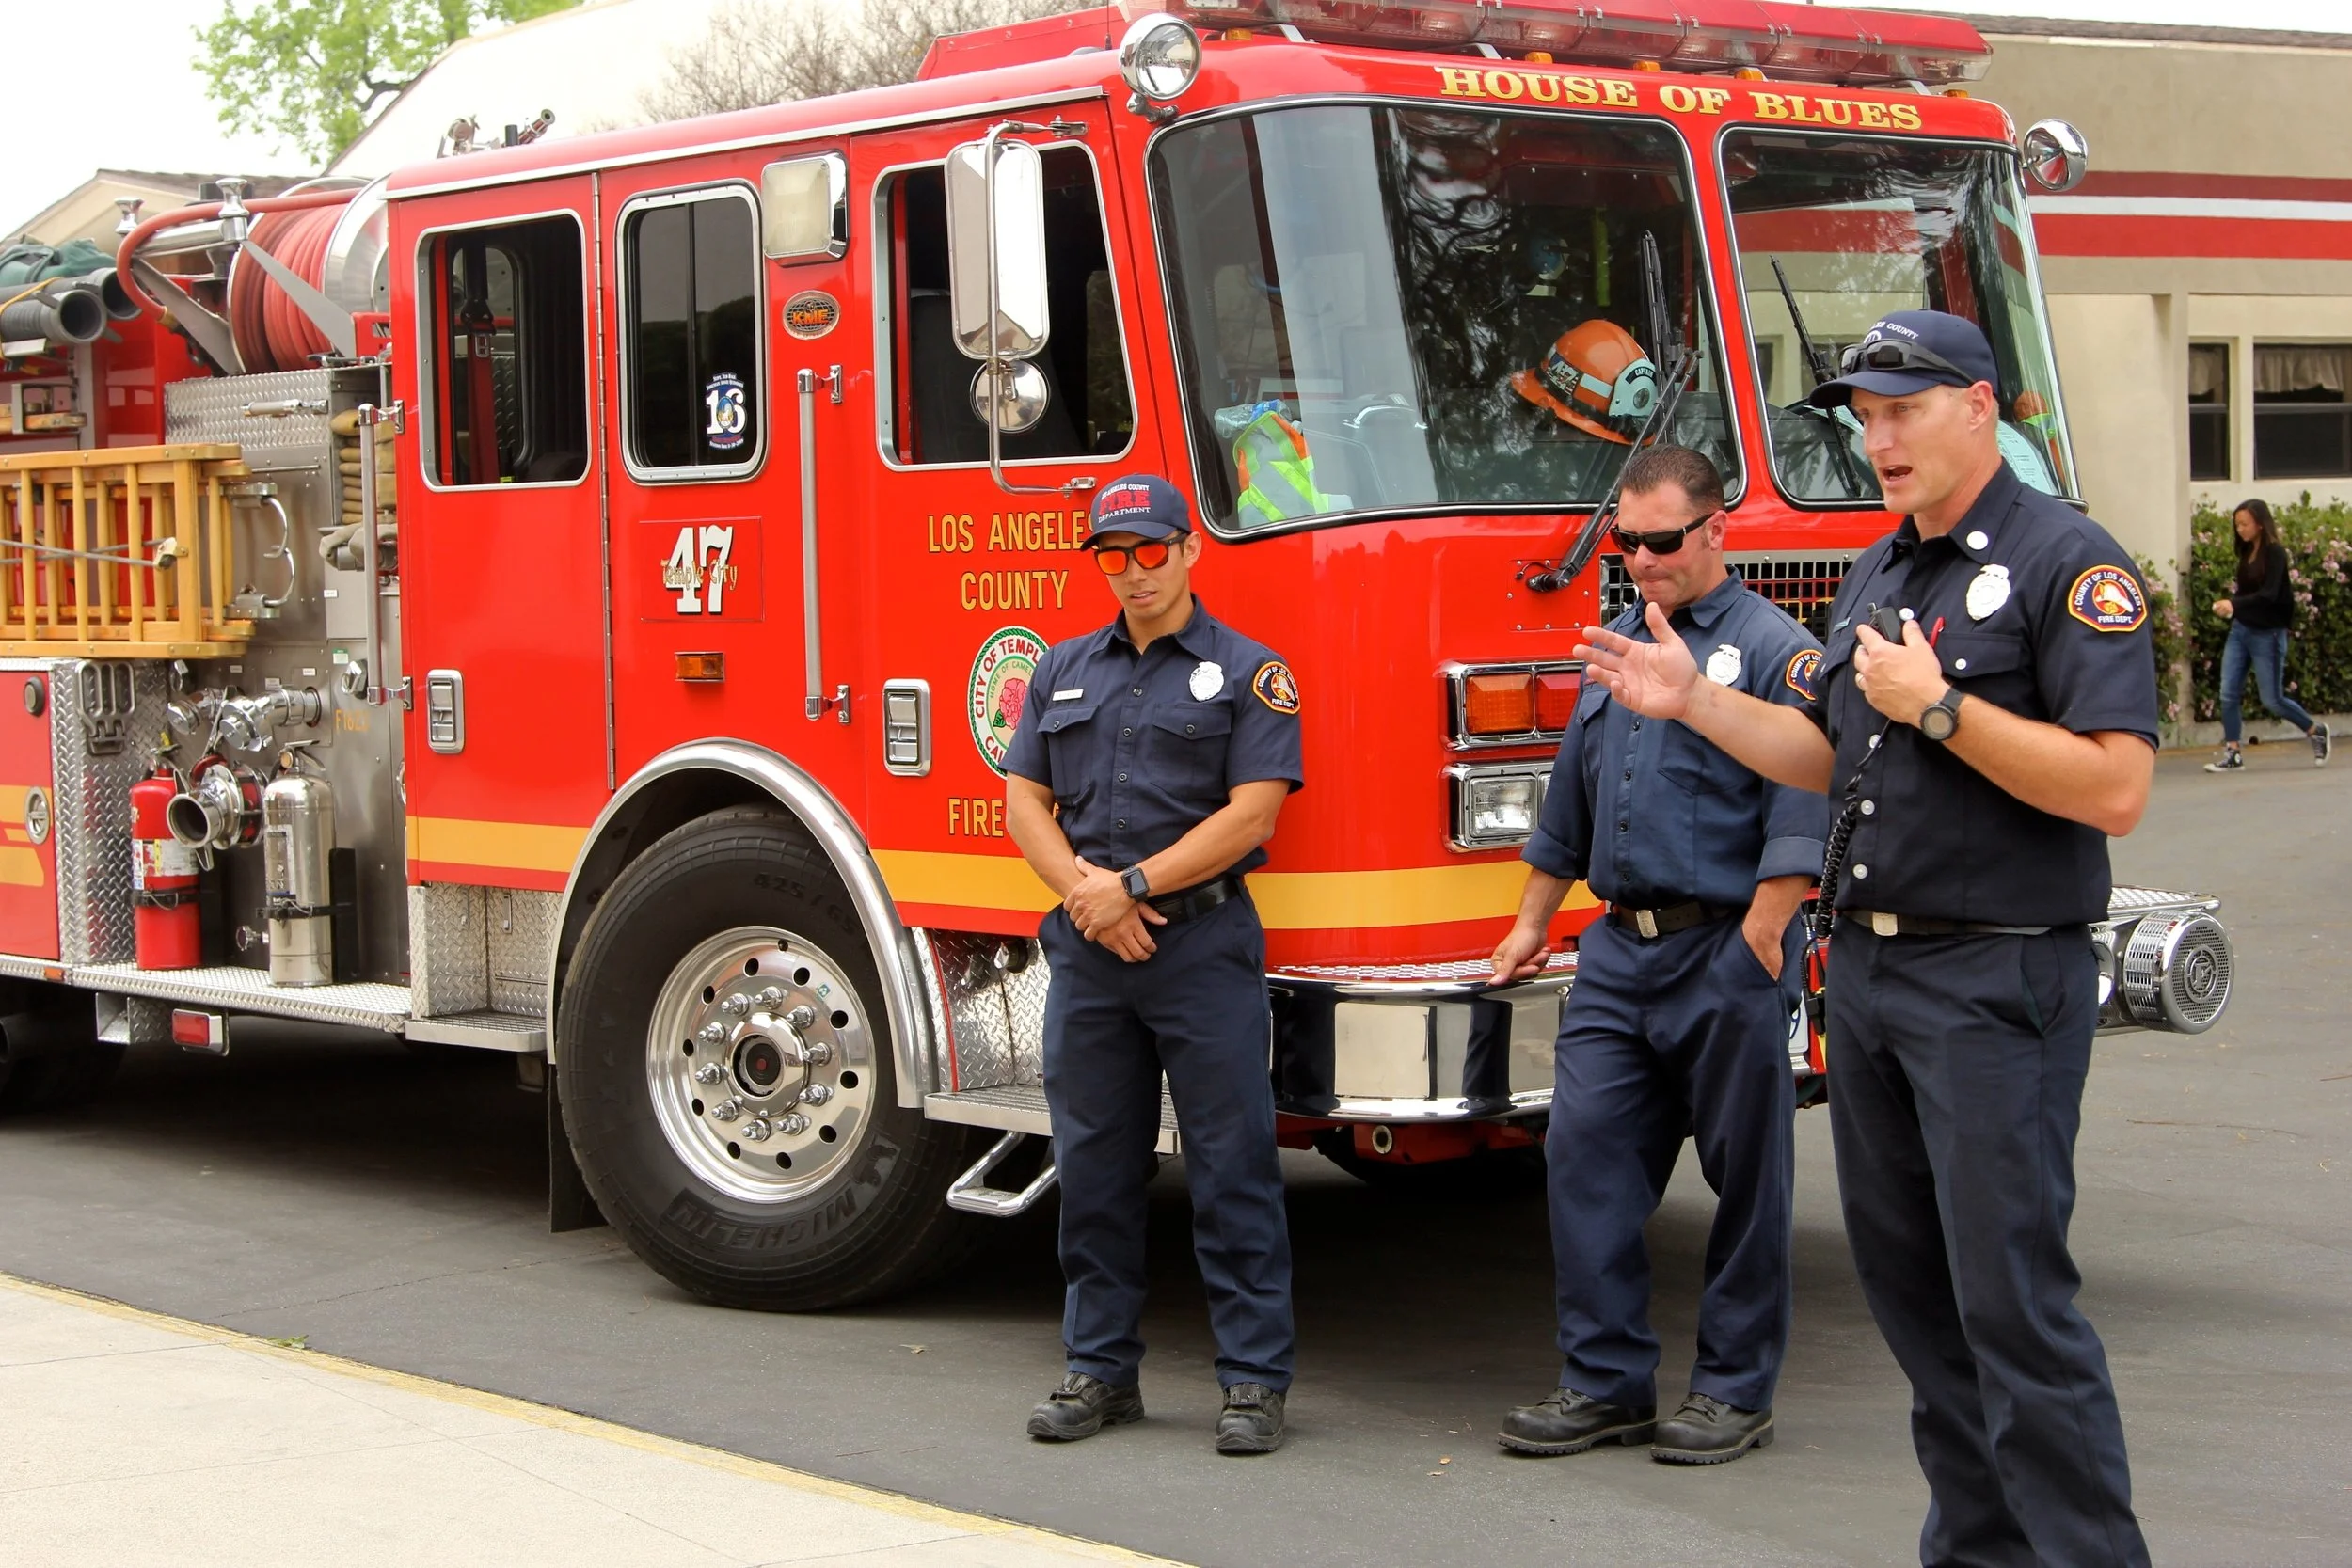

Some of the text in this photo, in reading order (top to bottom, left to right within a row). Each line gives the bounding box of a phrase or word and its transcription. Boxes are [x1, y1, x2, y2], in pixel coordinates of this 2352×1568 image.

[1435, 66, 1923, 131] HOUSE OF BLUES
[791, 309, 830, 325] KME
[1886, 322, 1919, 340] COUNTY
[706, 388, 746, 435] 16
[1098, 507, 1152, 524] DEPARTMENT
[1099, 490, 1151, 516] FIRE
[928, 510, 1094, 553] LOS ANGELE
[664, 524, 734, 614] 47
[961, 570, 1069, 610] COUNTY
[2074, 571, 2142, 607] COUNTY OF LOS ANGELES
[2097, 615, 2114, 624] FIRE
[975, 638, 1040, 719] CITY OF TEMPL
[990, 660, 1033, 698] HOME OF CAMEL
[948, 798, 1004, 837] FIRE
[666, 1186, 857, 1248] MICHELIN
